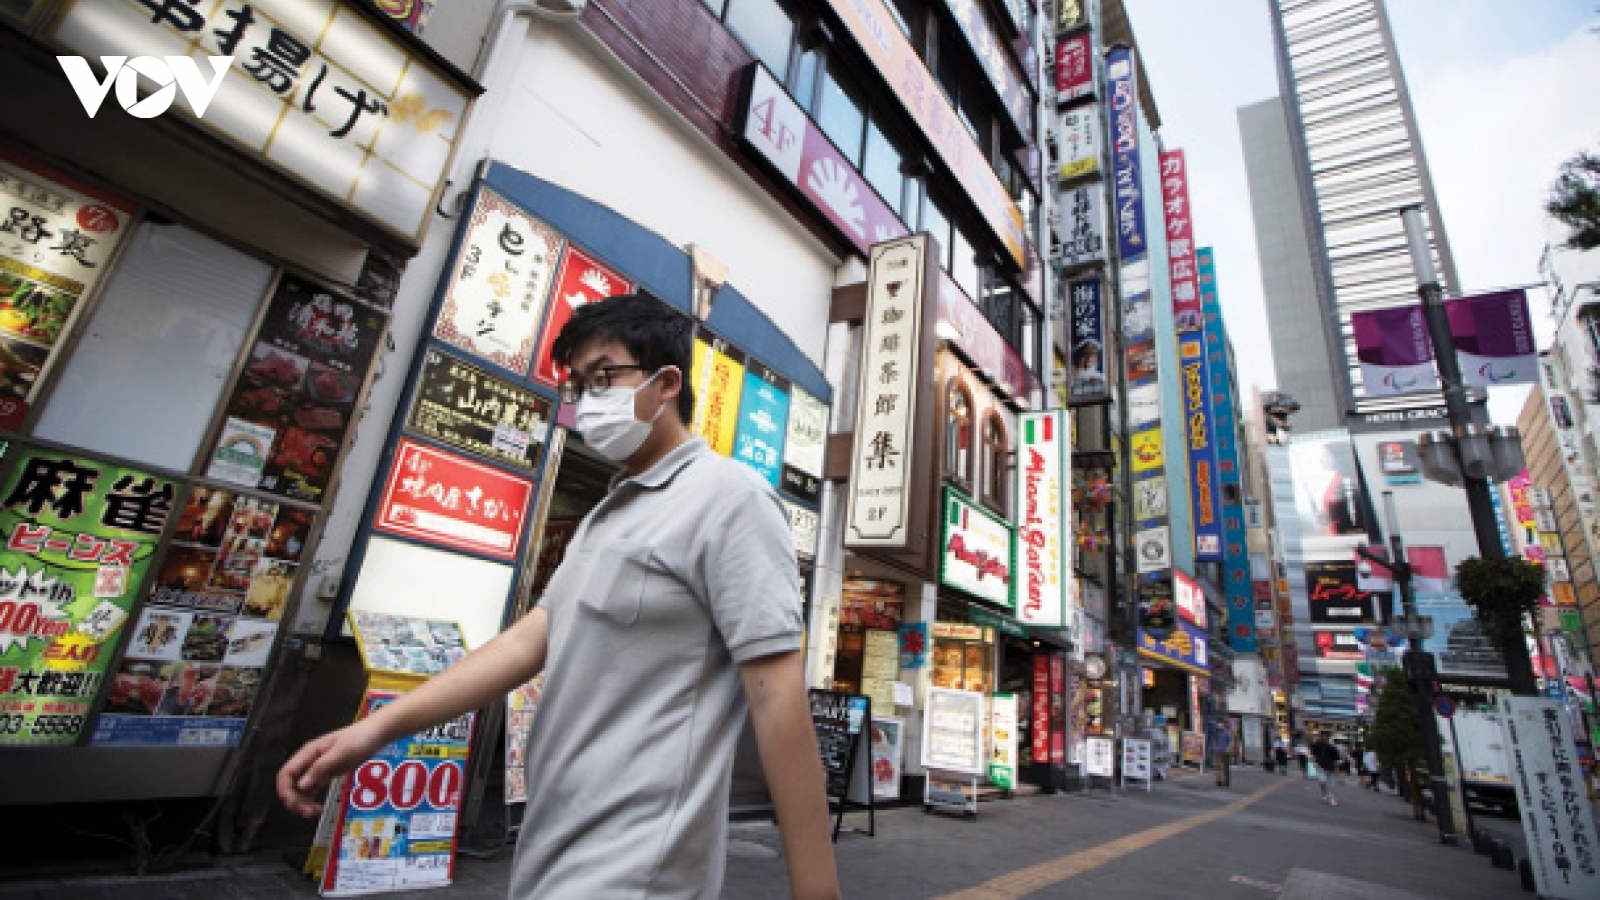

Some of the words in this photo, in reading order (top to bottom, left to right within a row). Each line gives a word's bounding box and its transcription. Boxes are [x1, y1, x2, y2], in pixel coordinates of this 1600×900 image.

[750, 95, 797, 152] 4F
[5, 456, 175, 534] 麻雀
[352, 760, 461, 811] 800
